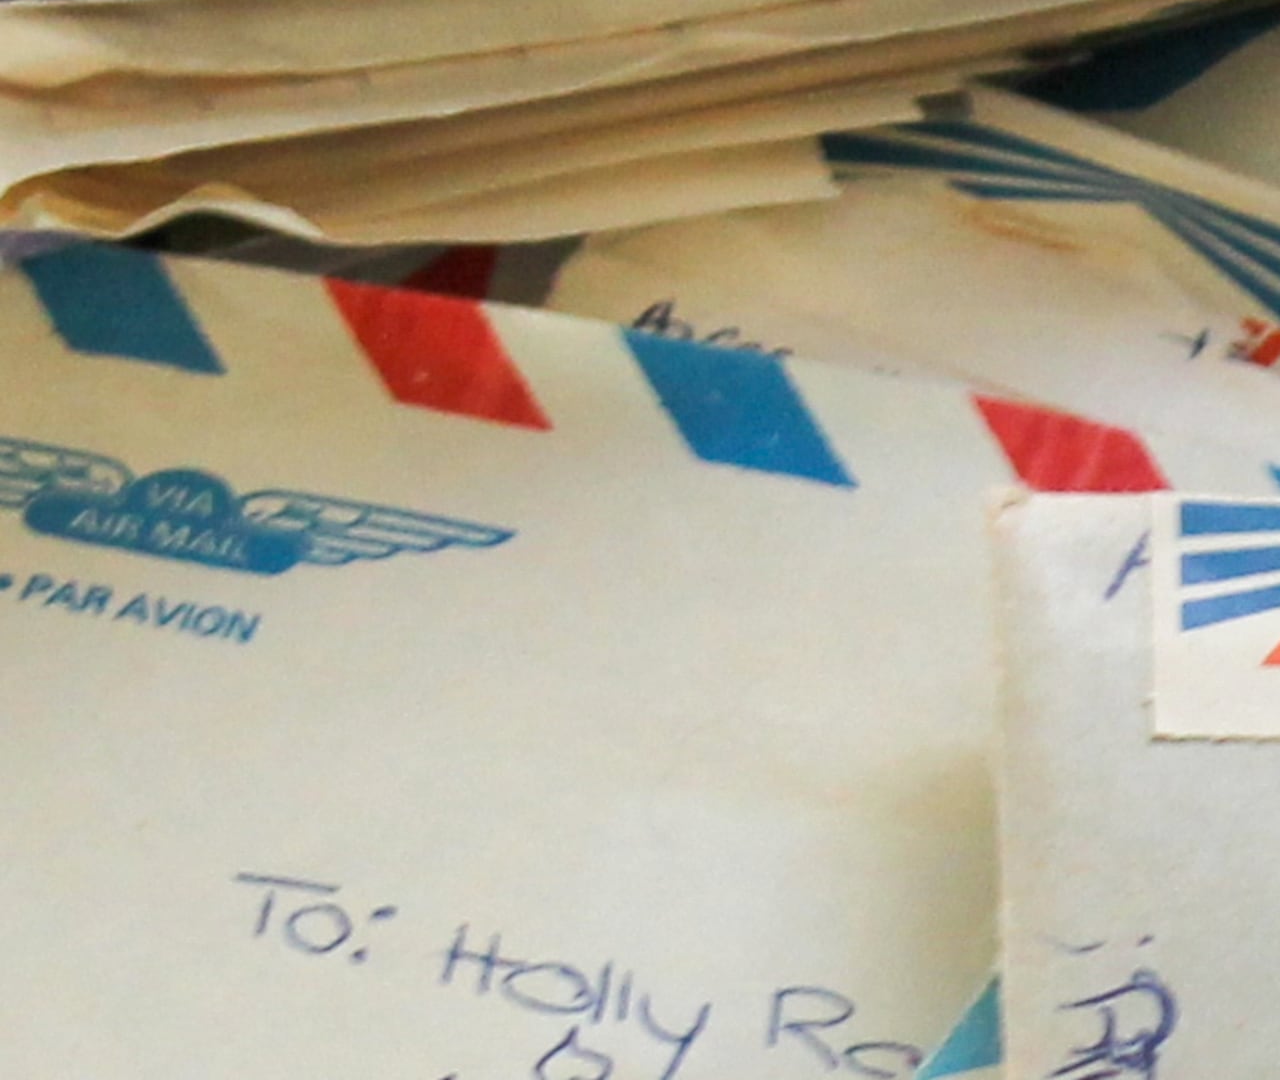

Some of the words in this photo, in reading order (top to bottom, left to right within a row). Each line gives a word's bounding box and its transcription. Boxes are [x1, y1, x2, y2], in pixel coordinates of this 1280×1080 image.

[144, 482, 216, 517] VIA
[69, 507, 144, 542] AIR
[151, 522, 249, 565] MAIL
[18, 573, 114, 614] PAR
[115, 593, 262, 644] AVION
[232, 872, 400, 966] To:
[436, 923, 714, 1080] Holly
